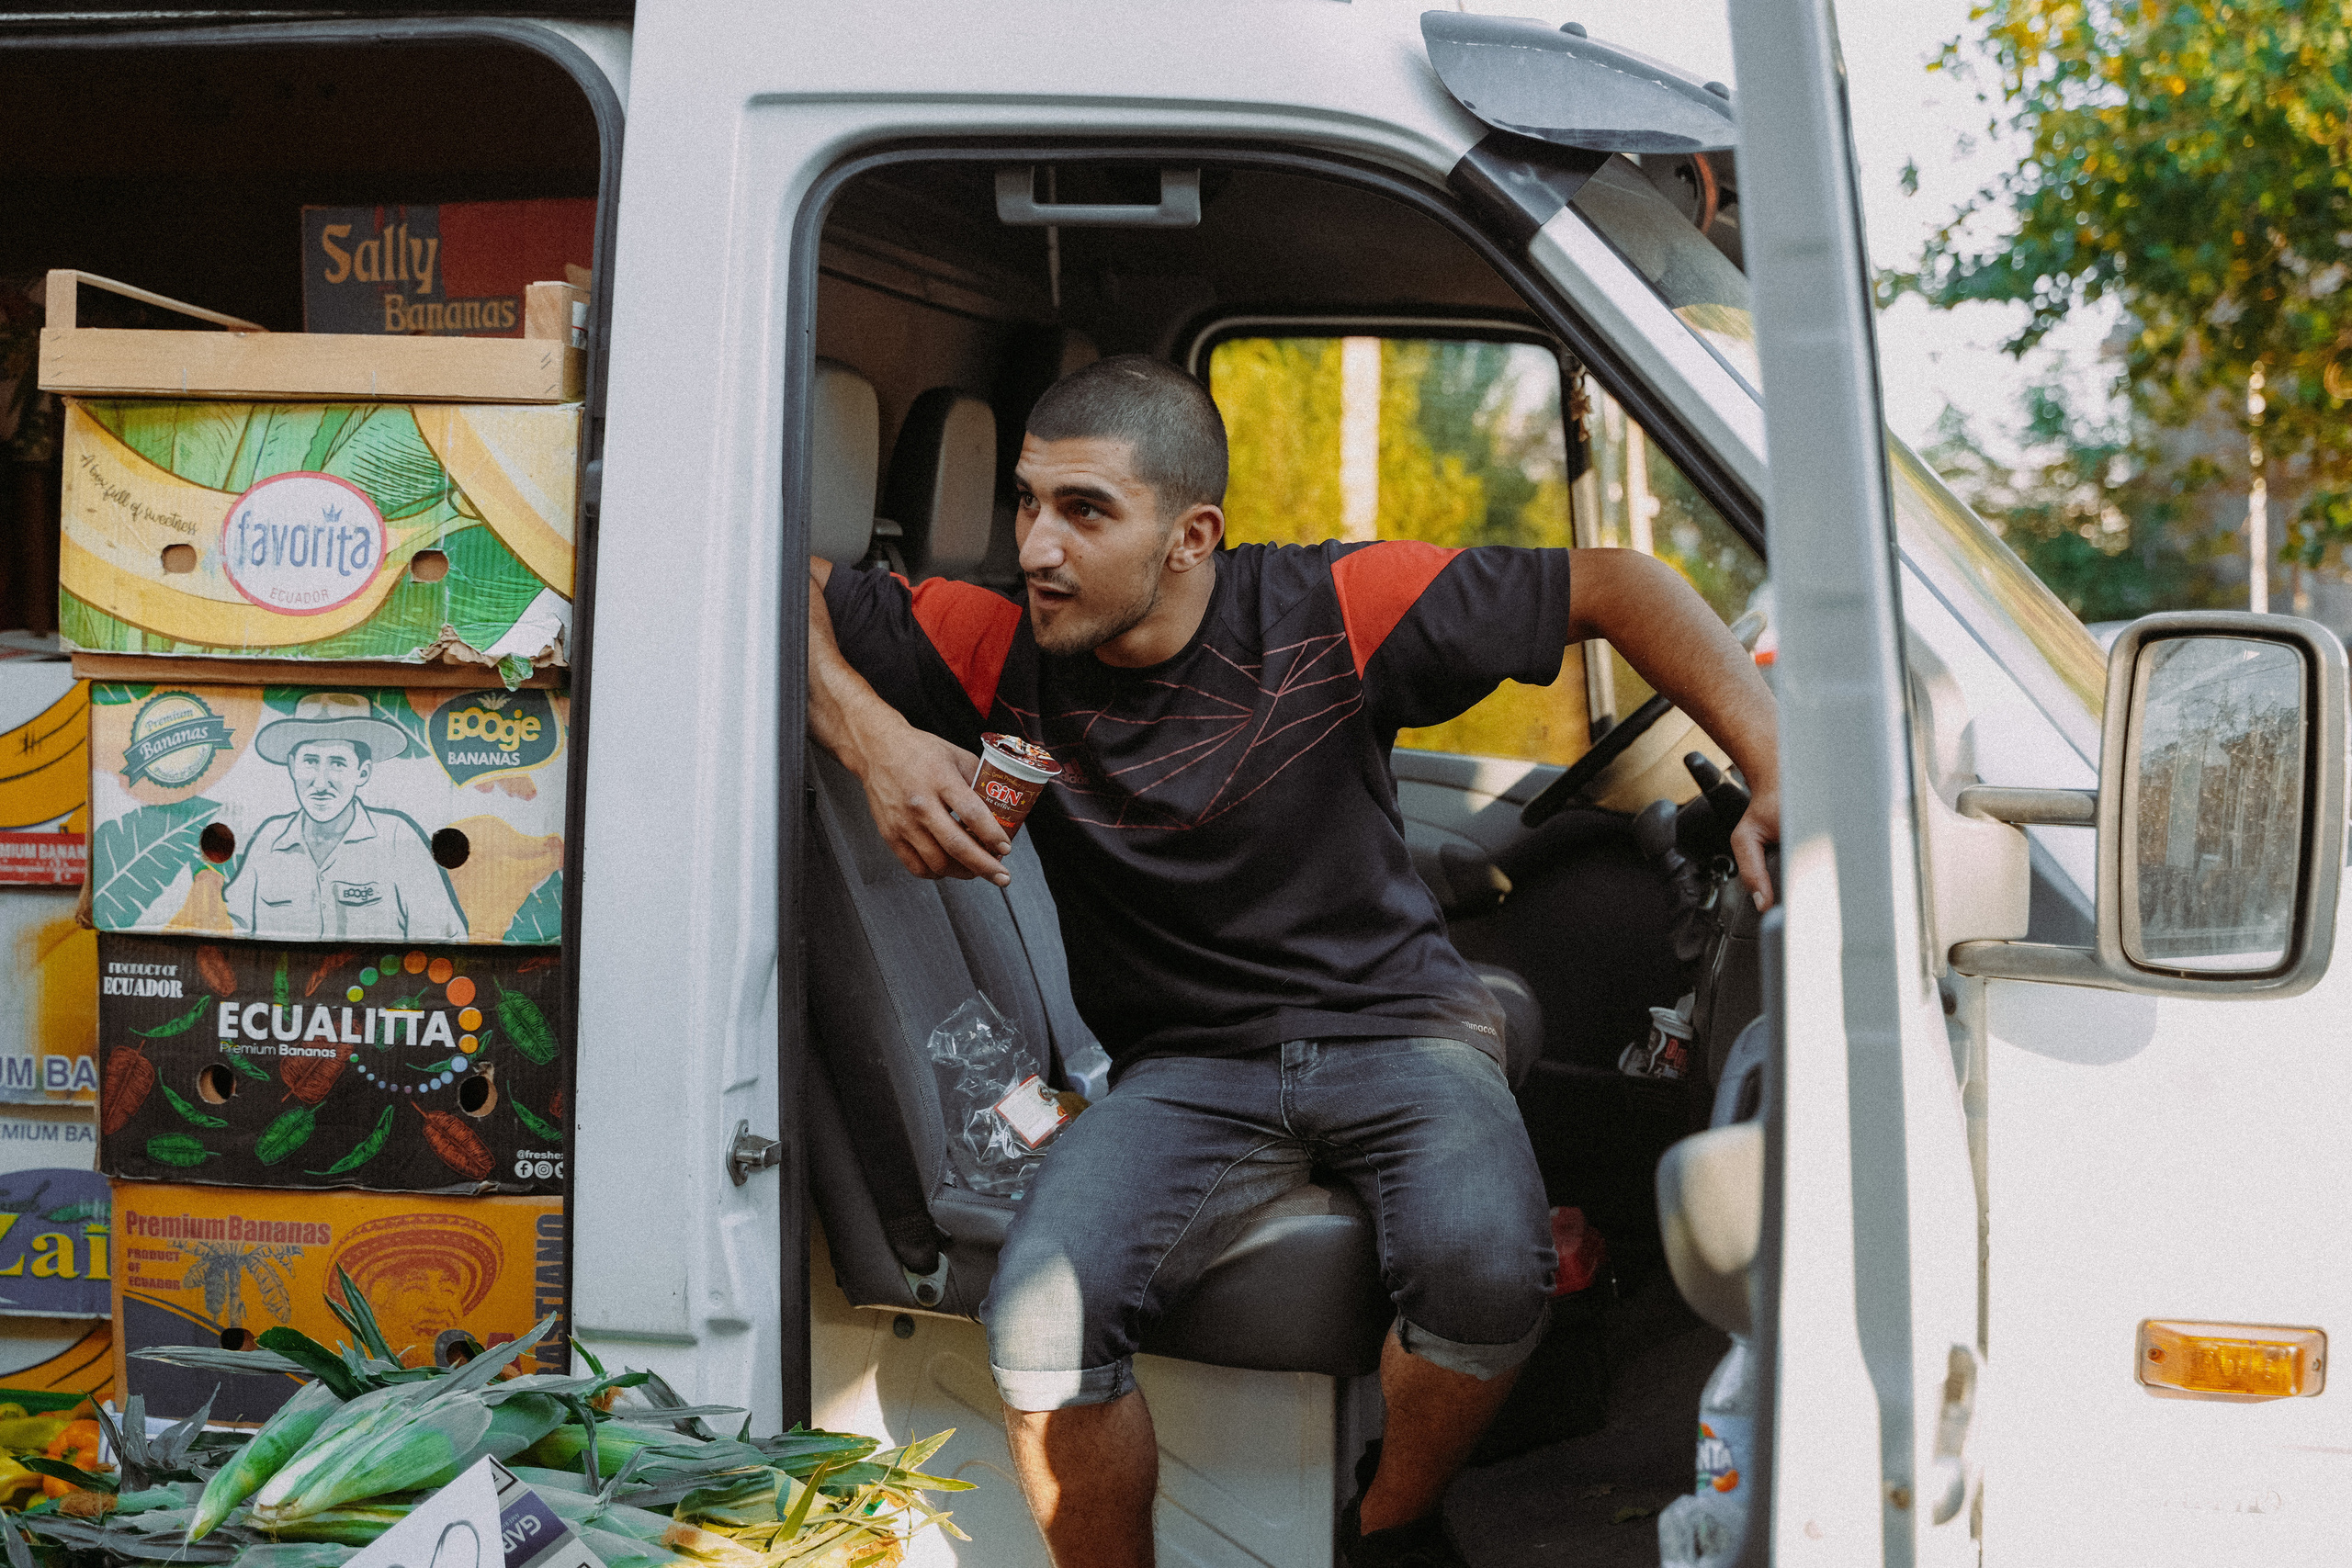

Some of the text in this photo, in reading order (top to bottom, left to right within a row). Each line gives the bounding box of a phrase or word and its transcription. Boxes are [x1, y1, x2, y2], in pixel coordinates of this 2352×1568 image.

[322, 223, 438, 294] Sally
[384, 294, 516, 332] Bananas
[90, 465, 108, 488] box
[103, 485, 131, 507] full
[130, 502, 142, 522] of
[144, 508, 198, 536] sweetness
[238, 510, 370, 576] favorita
[270, 587, 330, 604] ECUADOR
[146, 708, 194, 732] Premium
[140, 727, 209, 761] Bananas
[447, 751, 521, 766] BANANAS
[108, 963, 178, 976] PRODUCT OF
[103, 976, 184, 998] ECUADOR
[218, 1001, 457, 1047] ECUALITTA
[220, 1042, 336, 1058] Premium Bananas
[0, 1058, 32, 1087] M
[516, 1150, 563, 1160] @freshe
[127, 1247, 180, 1262] PRODUCT
[128, 1261, 141, 1273] OF
[129, 1276, 181, 1291] ECUADOR
